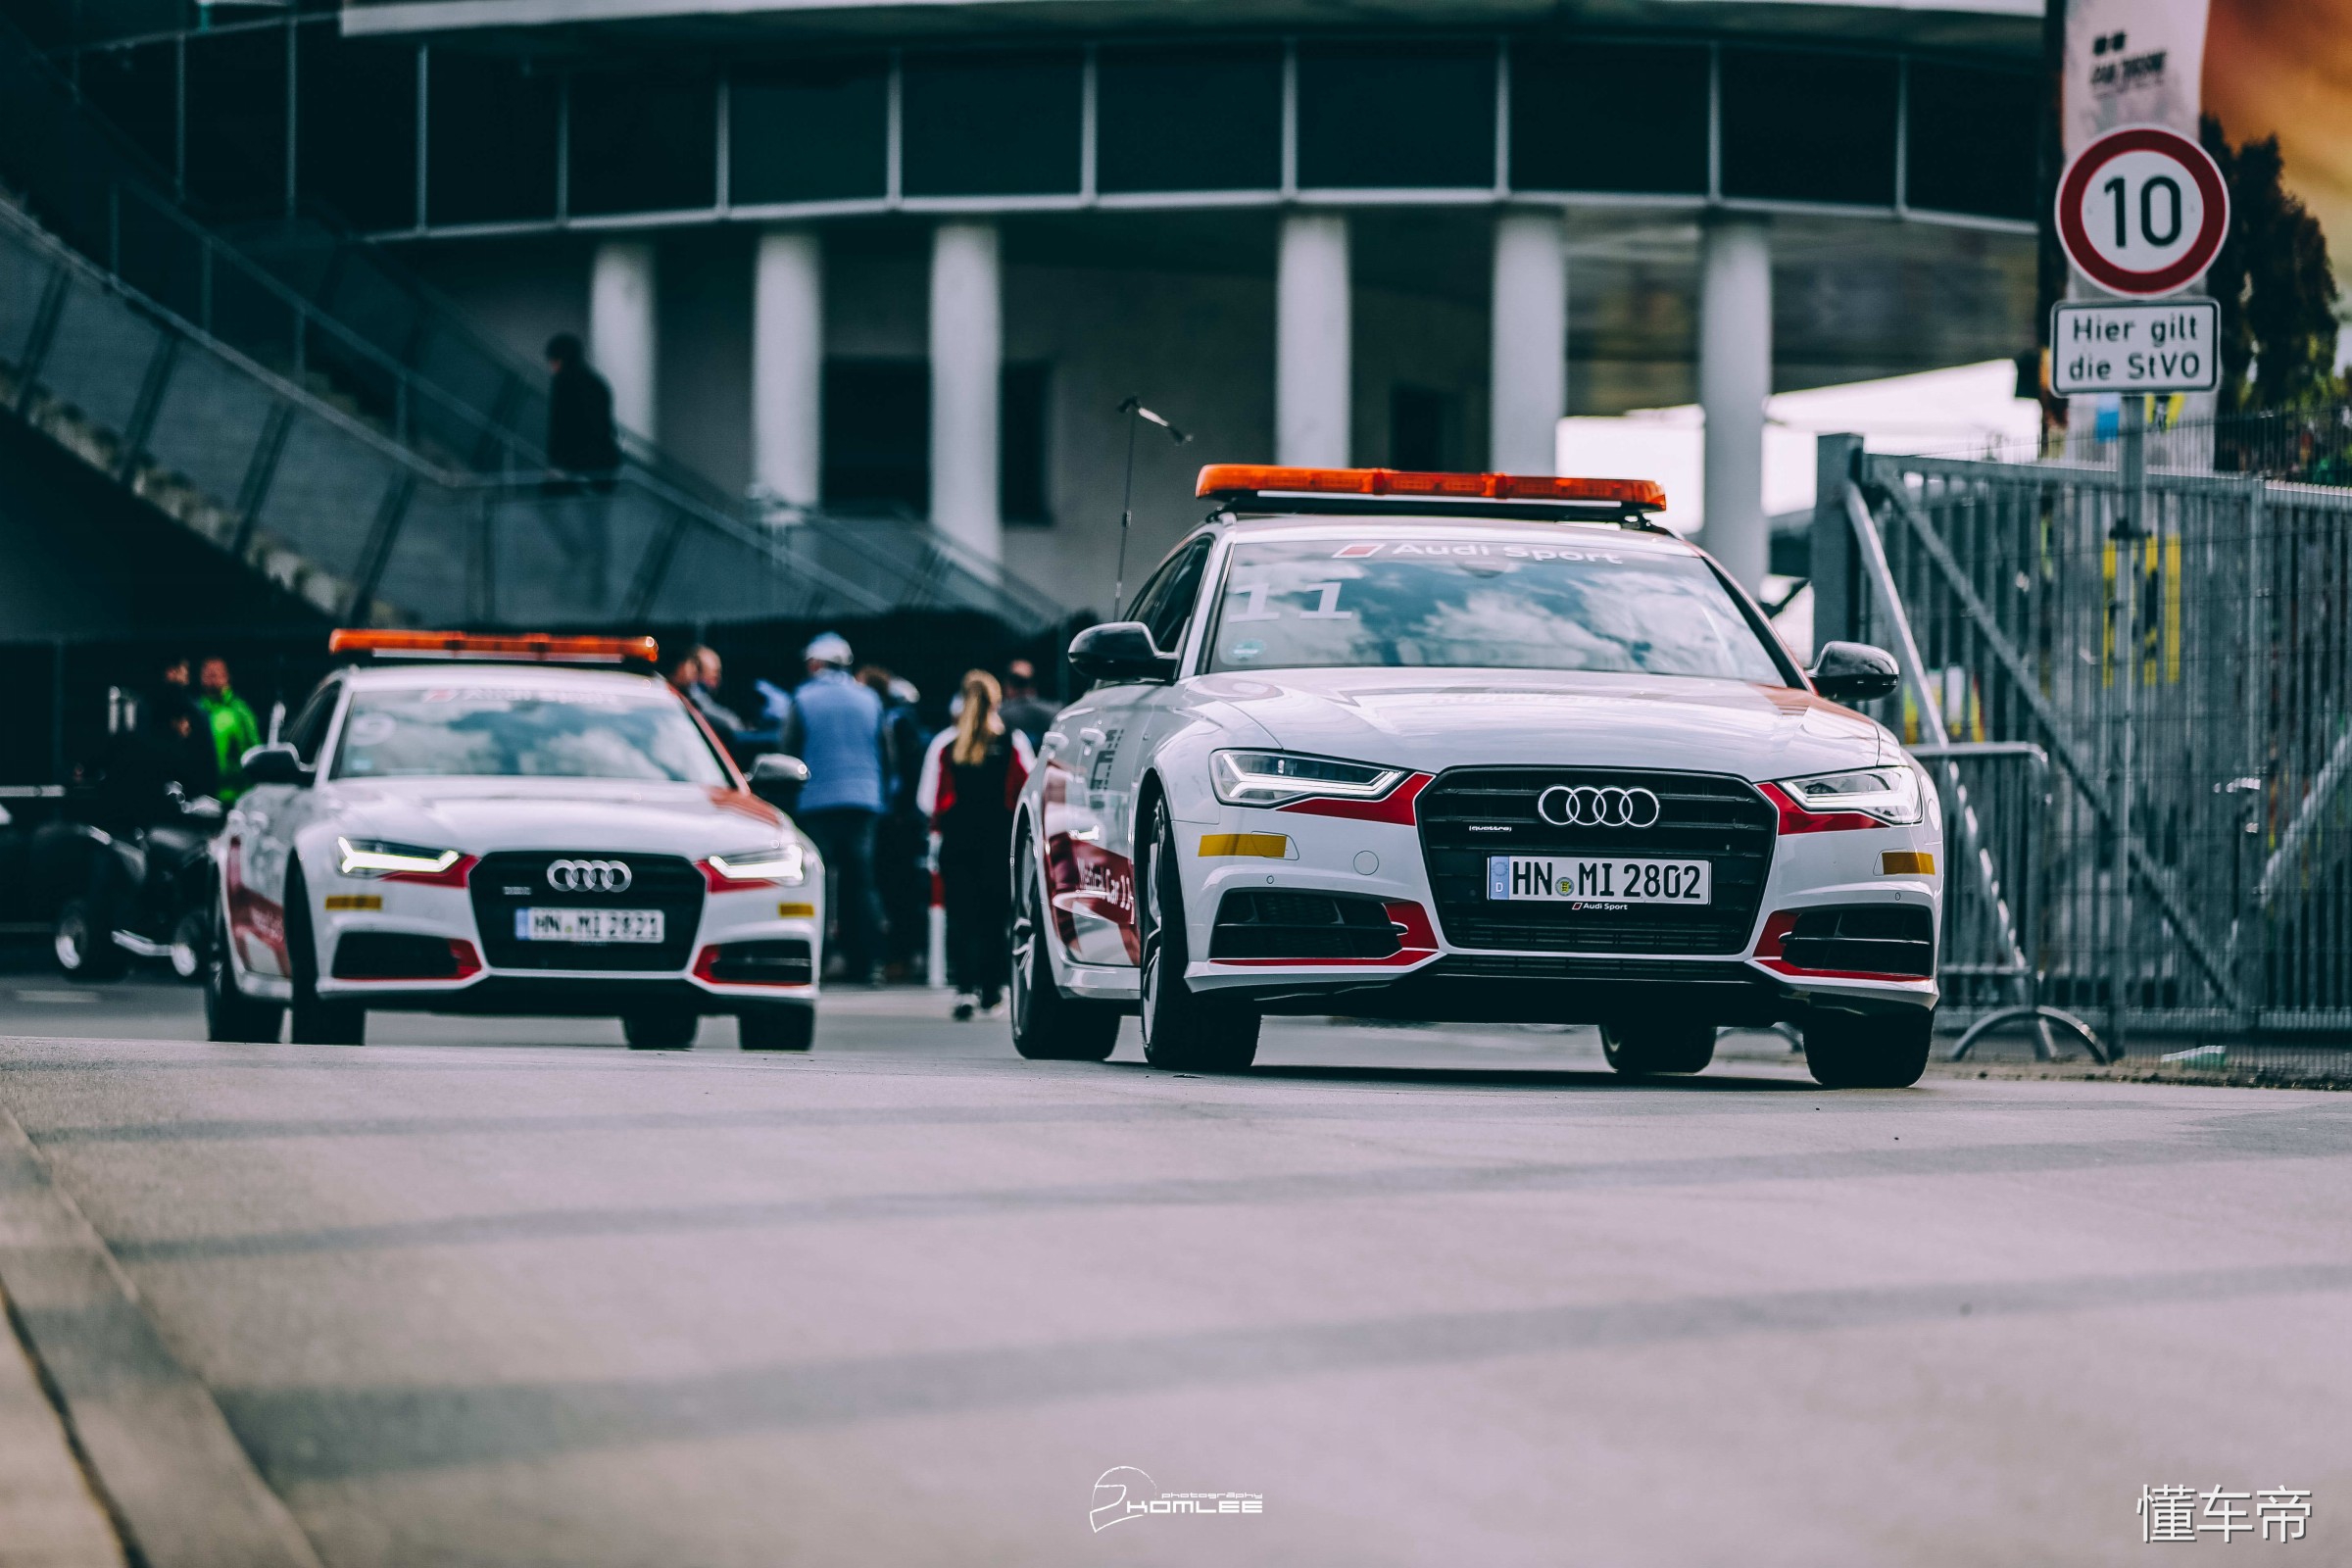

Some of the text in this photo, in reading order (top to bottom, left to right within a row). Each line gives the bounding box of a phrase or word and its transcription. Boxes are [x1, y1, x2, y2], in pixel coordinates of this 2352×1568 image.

[2104, 175, 2182, 249] 10
[2073, 314, 2197, 347] Hier gilt
[2069, 351, 2200, 381] die StVO
[1392, 543, 1623, 564] Audi Sport
[1228, 581, 1352, 623] 11
[1495, 881, 1503, 893] D
[1512, 860, 1701, 900] HN MI 2802
[1603, 903, 1628, 911] Sport
